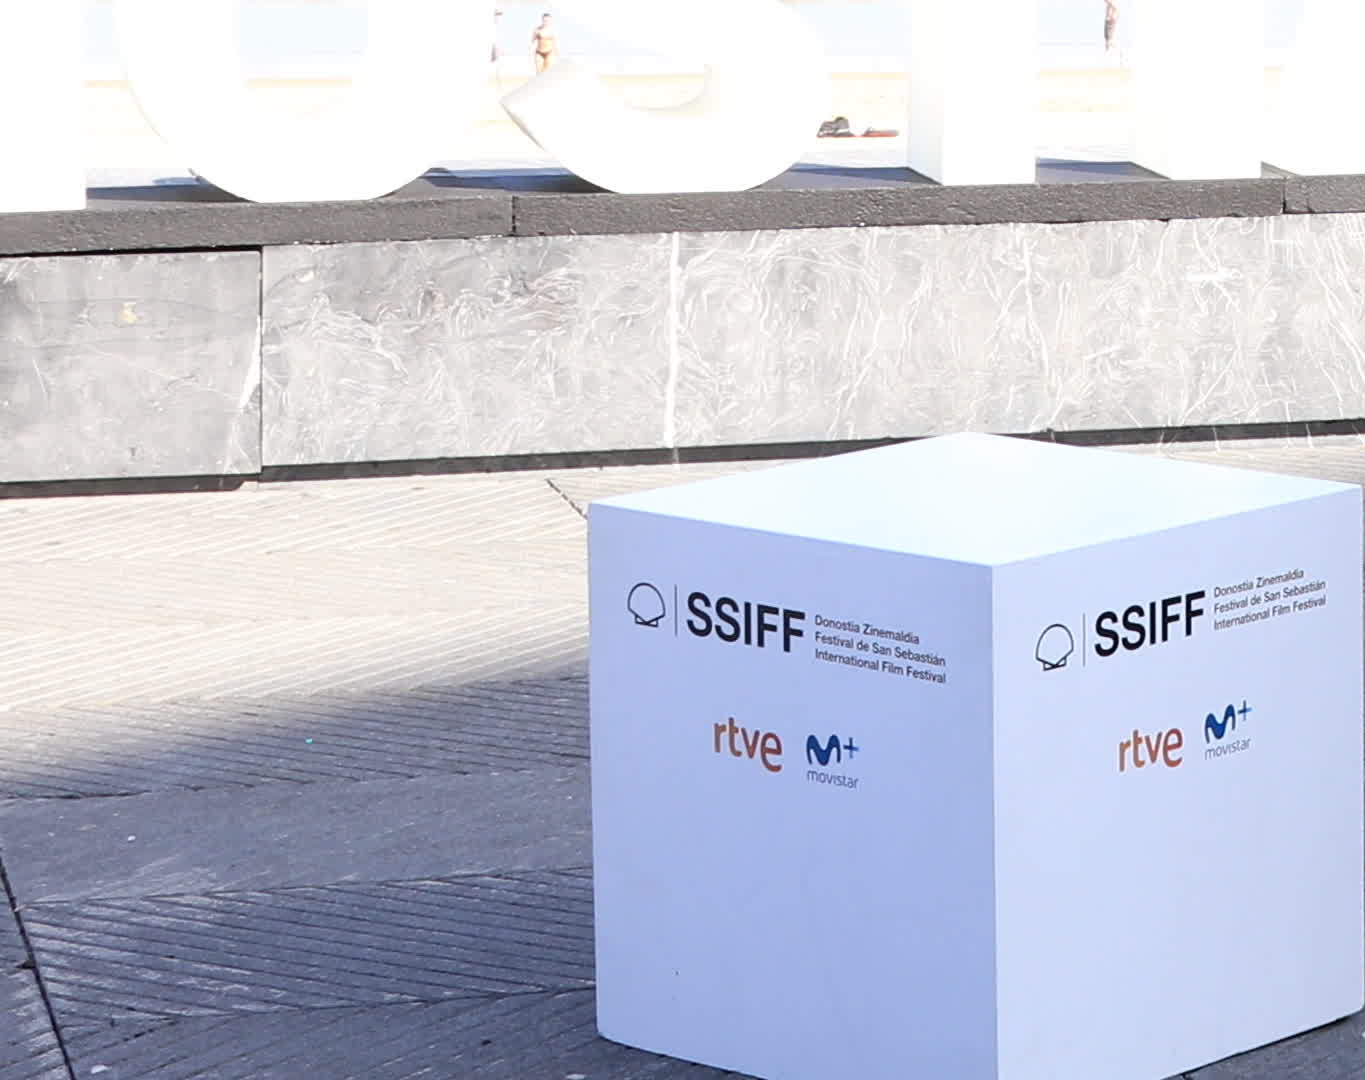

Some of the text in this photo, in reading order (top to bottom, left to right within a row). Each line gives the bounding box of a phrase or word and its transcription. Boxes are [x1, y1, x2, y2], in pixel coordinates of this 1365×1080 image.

[1214, 568, 1304, 598] Donostia Zinemaldia
[1214, 596, 1248, 614] Festival
[1250, 594, 1262, 606] de
[1264, 591, 1281, 602] San
[1214, 594, 1326, 630] International Film Festival
[687, 591, 806, 653] SSIFF
[814, 614, 920, 645] Donostia Zinemaldia
[1094, 590, 1205, 657] SSIFF
[815, 631, 854, 649] Festival
[856, 639, 869, 652] de
[872, 642, 892, 656] San
[815, 648, 946, 684] International Film Festival
[713, 717, 783, 773] rtve
[1119, 728, 1183, 772] rtve
[1204, 738, 1252, 760] movistar
[807, 770, 859, 789] movistar
